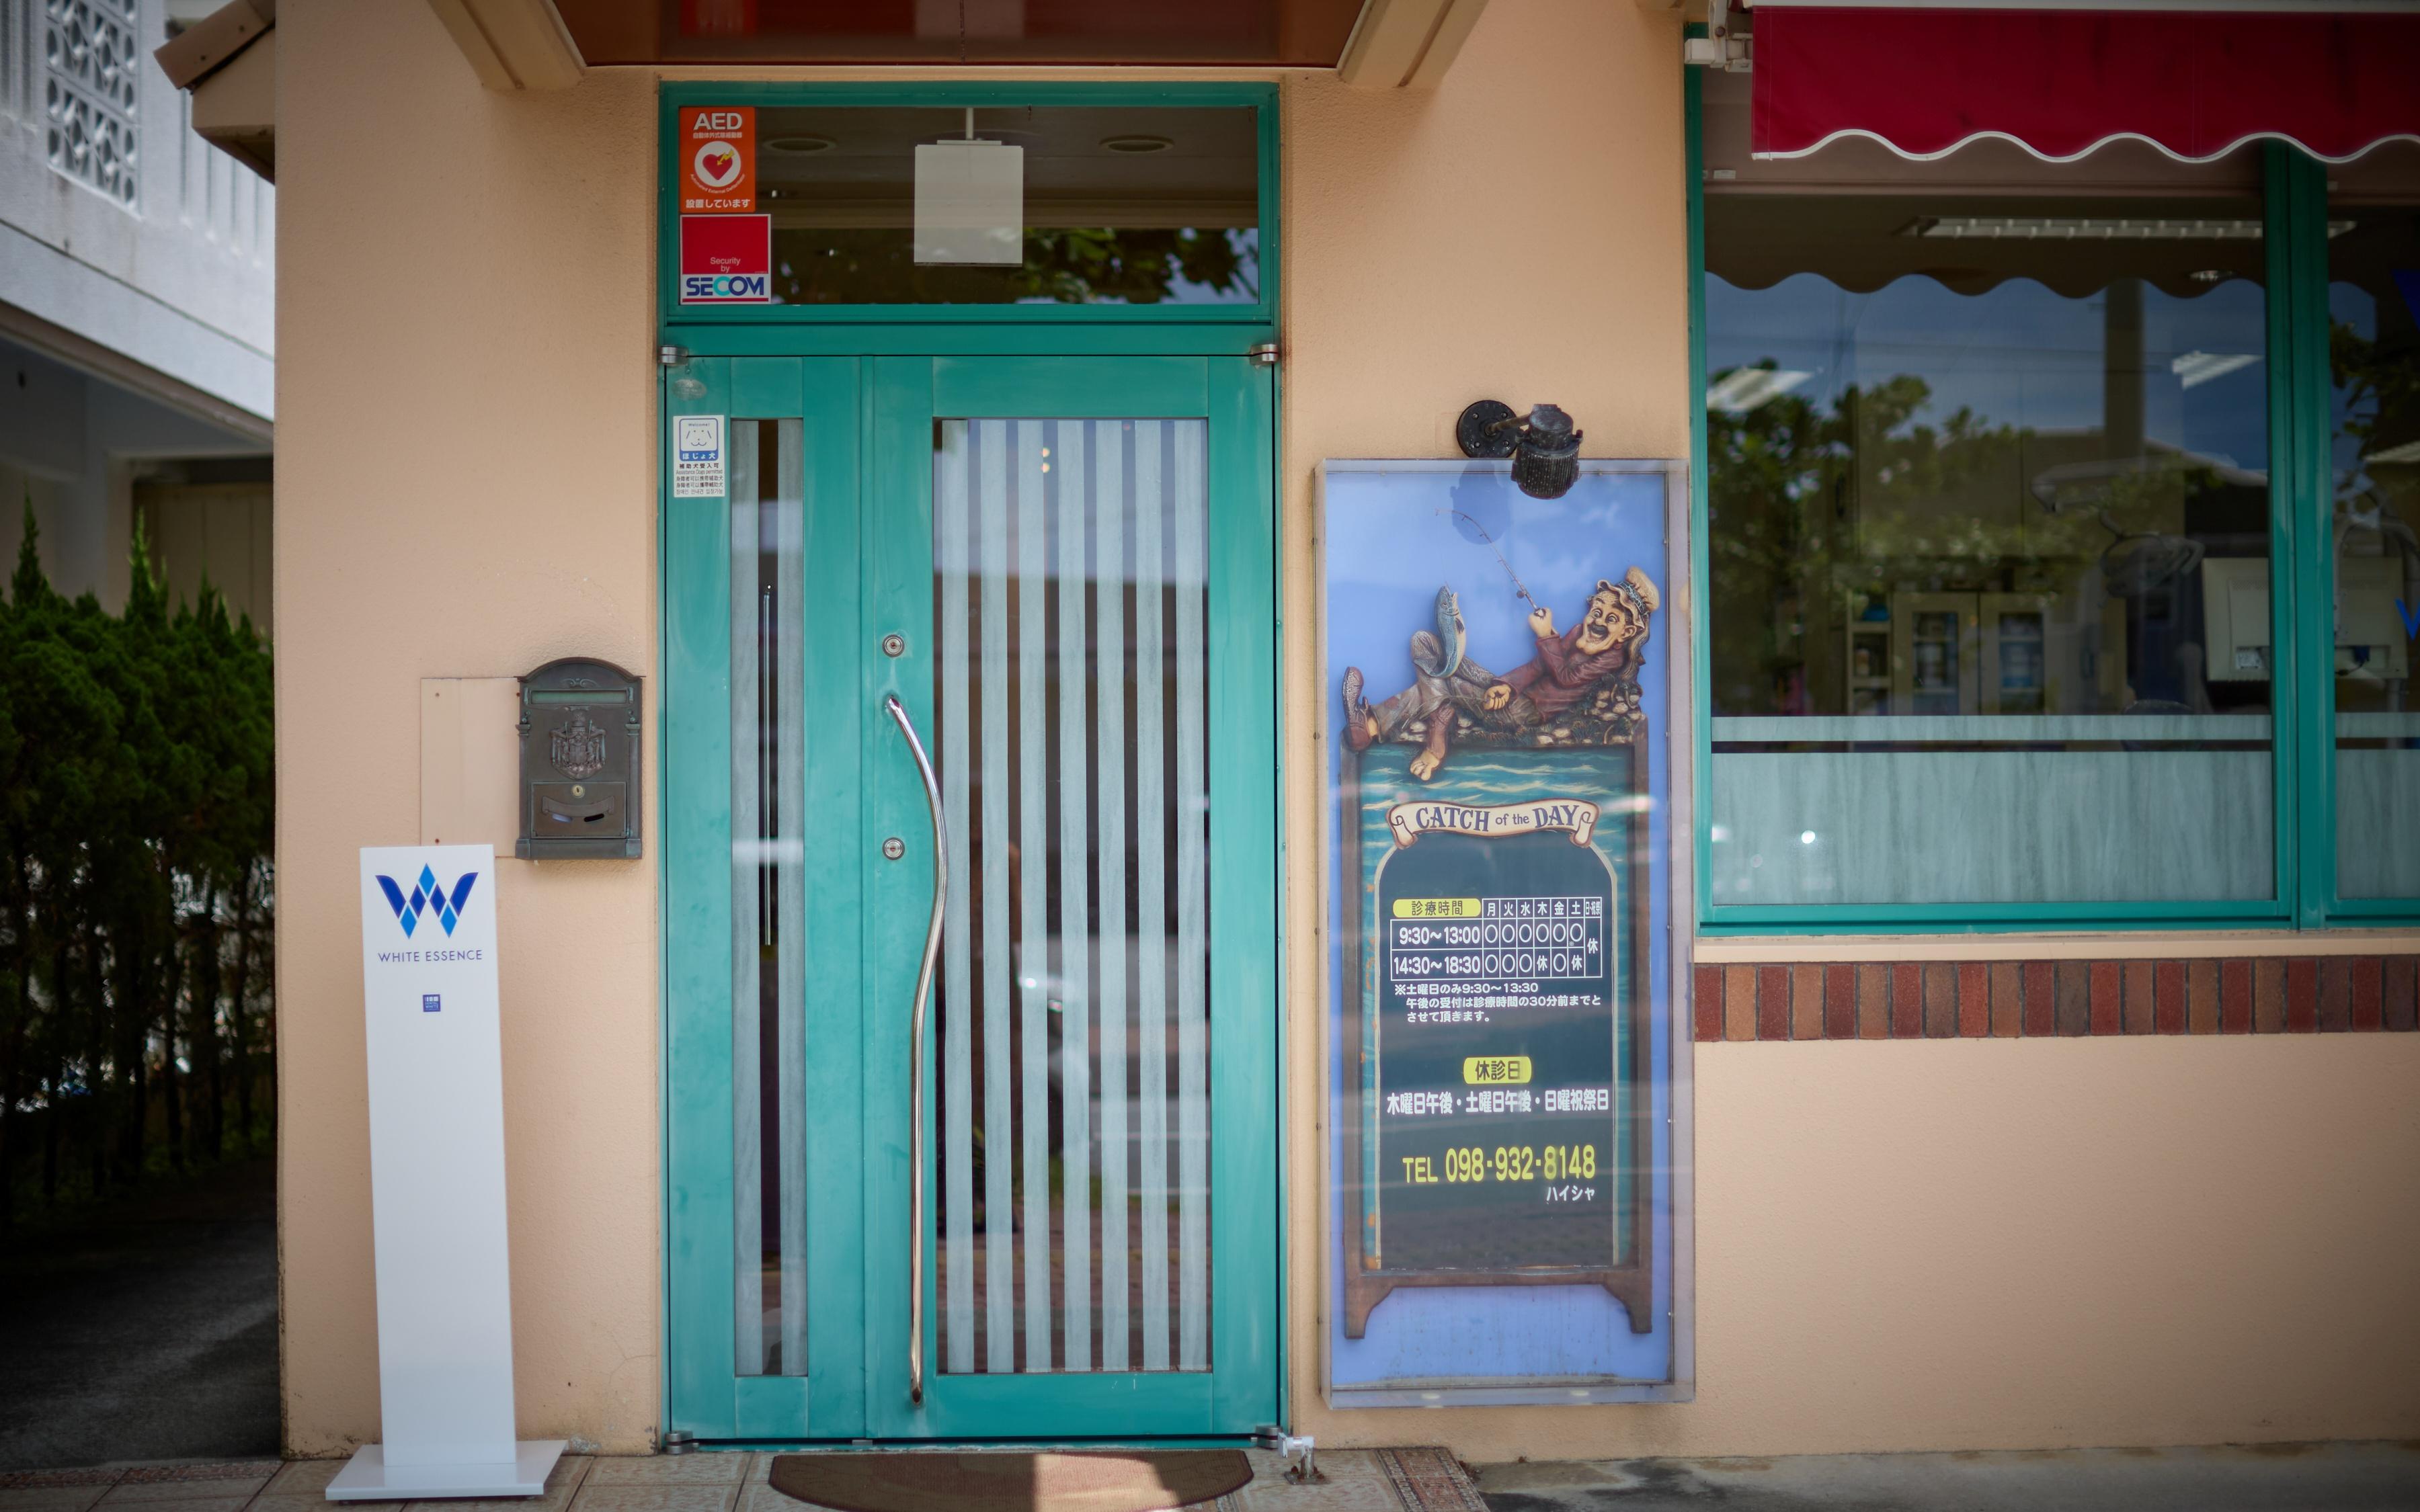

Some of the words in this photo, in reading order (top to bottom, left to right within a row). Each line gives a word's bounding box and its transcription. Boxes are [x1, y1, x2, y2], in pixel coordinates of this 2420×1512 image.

[693, 112, 743, 130] AED
[686, 199, 751, 208] 設置しています
[710, 257, 741, 265] Security
[721, 265, 730, 274] by
[686, 276, 764, 296] SECOM
[1415, 806, 1490, 832] CATCH
[1495, 813, 1509, 825] of
[1513, 813, 1530, 825] the
[1532, 804, 1580, 829] DAY
[1411, 900, 1463, 916] 診療時間
[1487, 902, 1496, 917] 月
[1503, 902, 1514, 917] 火
[1520, 902, 1531, 916] 水
[1537, 901, 1547, 915] 木
[1554, 901, 1564, 915] 金
[1571, 901, 1581, 915] 土
[1587, 937, 1599, 955] 休
[377, 952, 419, 963] WHITE
[426, 950, 483, 962] ESSENCE
[1537, 955, 1548, 972] 休
[1571, 954, 1582, 971] 休
[1406, 995, 1601, 1009] 午後の受付は診療時間の30分前までと
[1407, 1011, 1490, 1023] させて頂きます。
[1475, 1060, 1521, 1081] 休診日
[1402, 1157, 1439, 1183] TEL
[1546, 1185, 1595, 1202] ハイシャ
